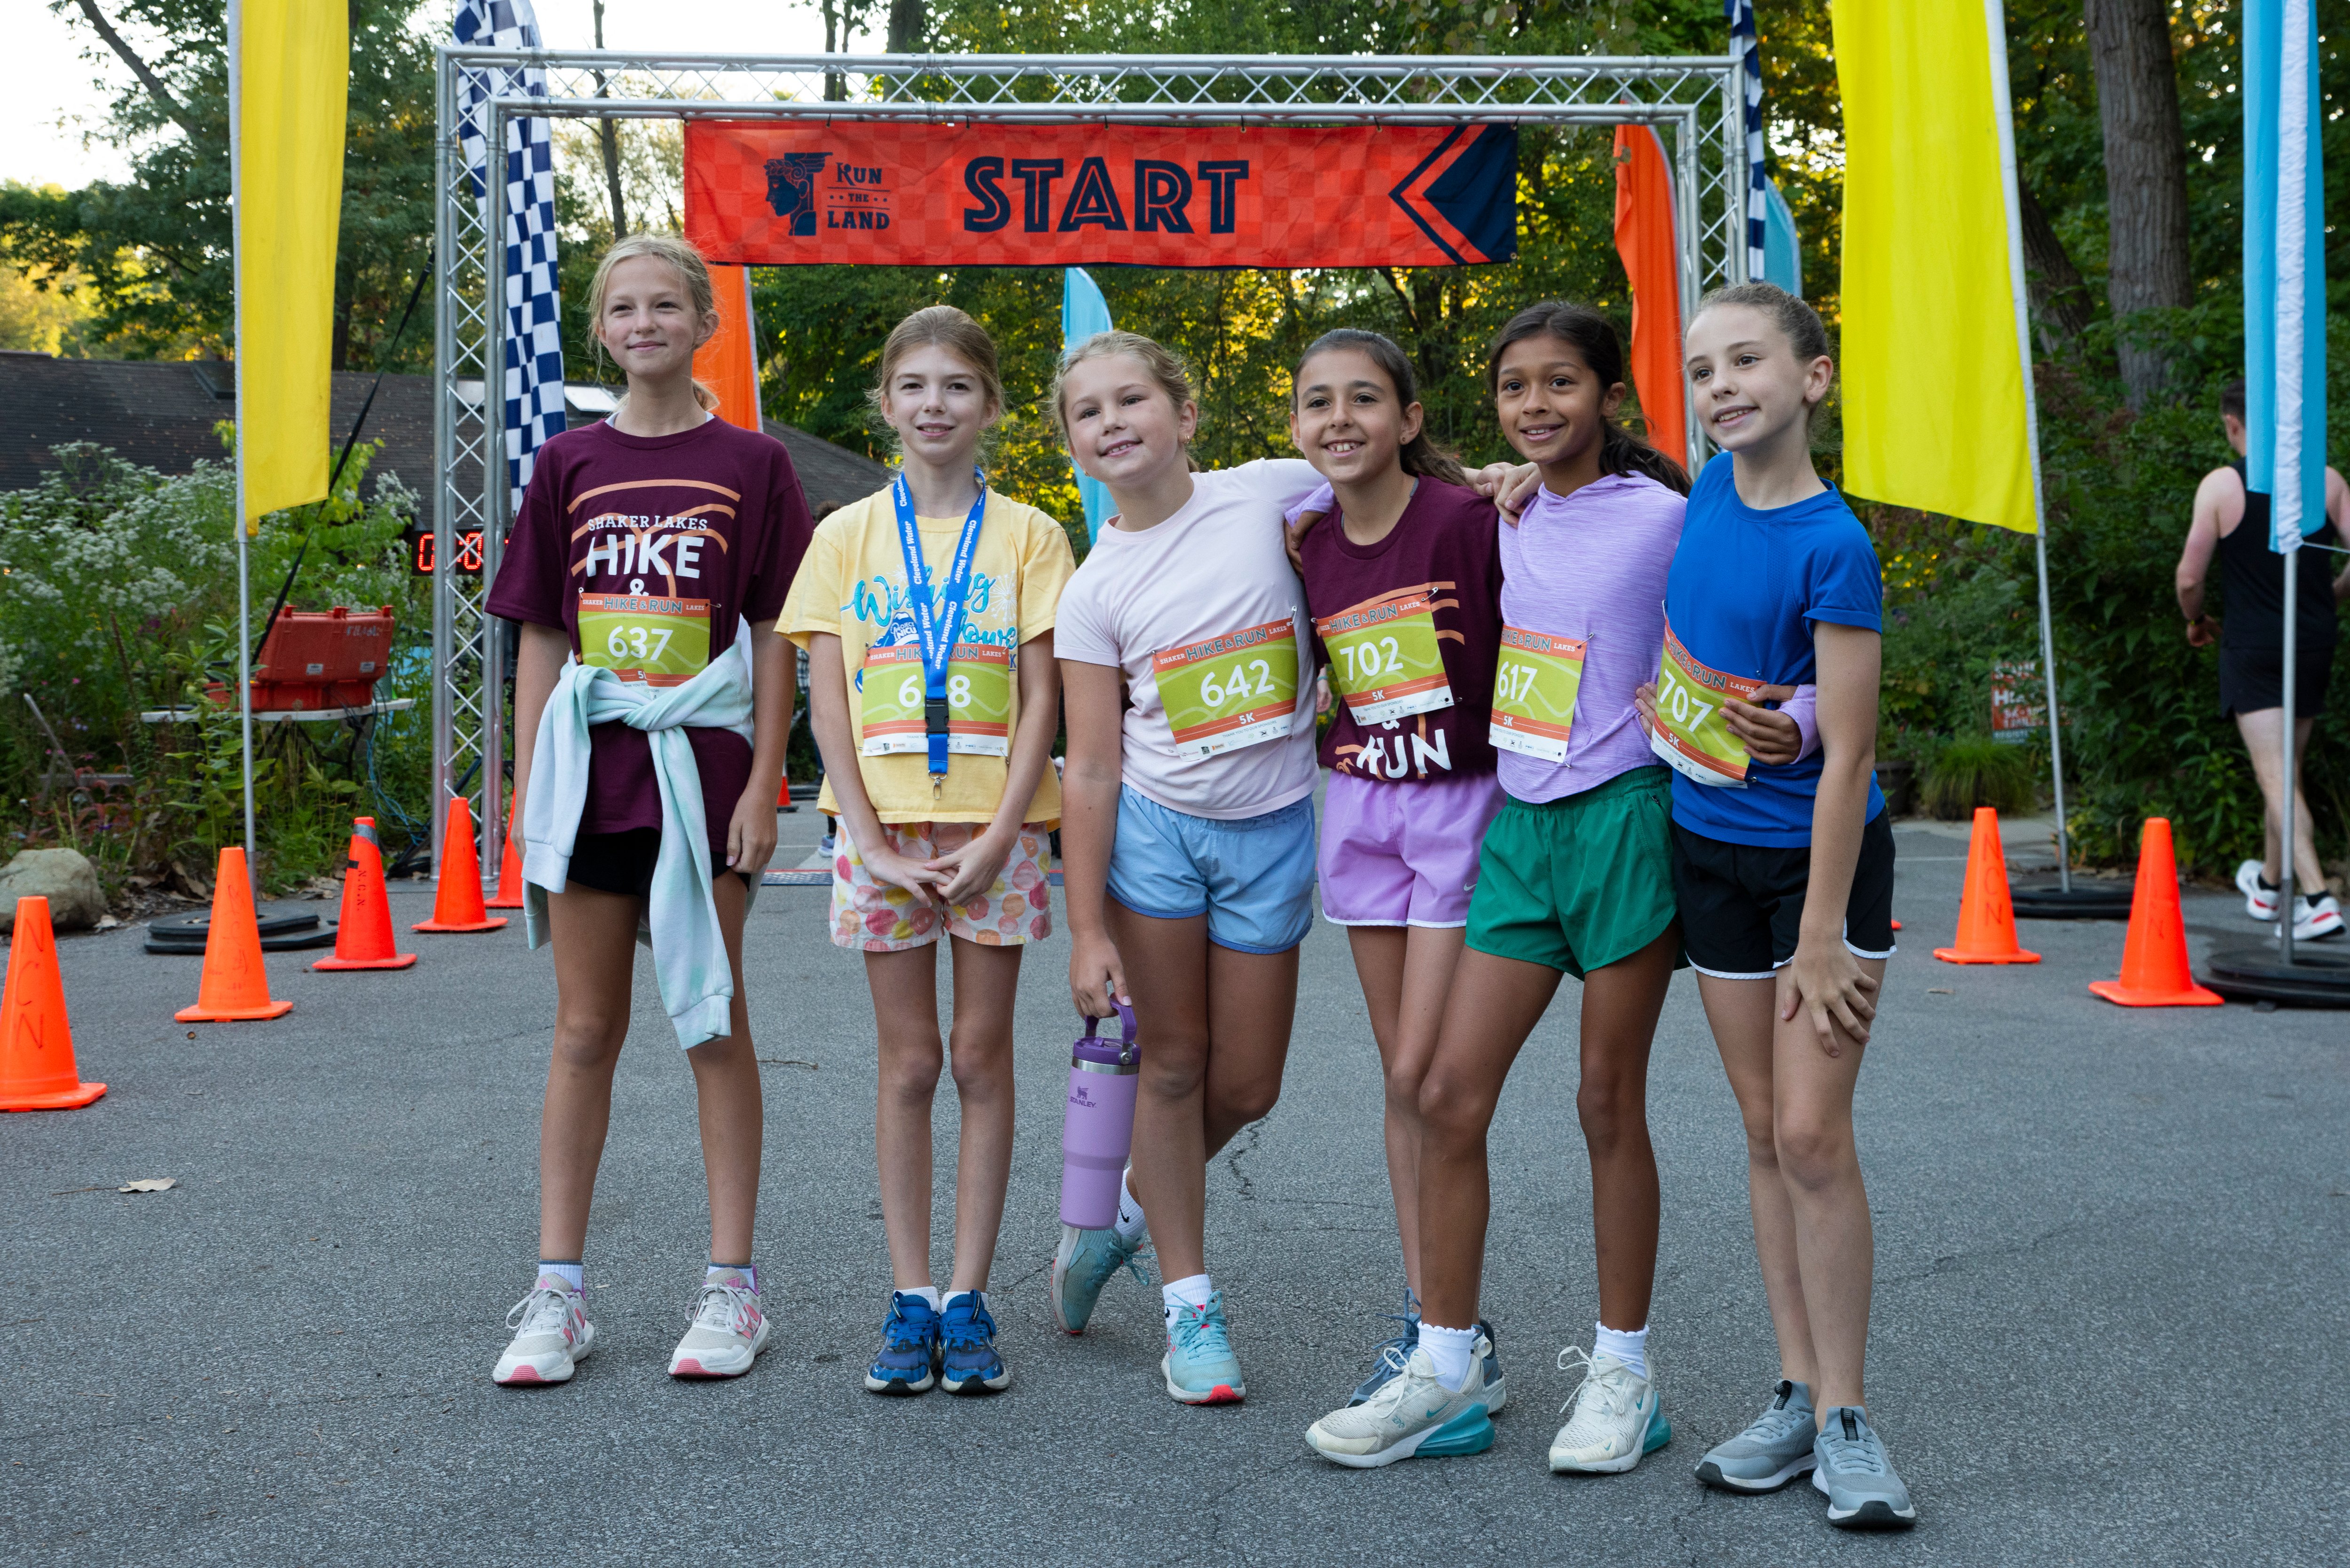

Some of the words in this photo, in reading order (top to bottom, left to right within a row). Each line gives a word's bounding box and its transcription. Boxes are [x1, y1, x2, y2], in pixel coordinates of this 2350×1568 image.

[836, 163, 882, 186] RUN
[848, 193, 870, 203] THE
[964, 156, 1249, 234] START
[827, 211, 890, 230] LAND
[588, 515, 650, 531] SHAKER
[654, 515, 708, 531] LAKES
[904, 521, 915, 545] Water
[960, 520, 977, 558] Cleveland
[586, 533, 705, 579] HIKE
[908, 546, 922, 585] Cleveland
[954, 559, 967, 584] Water
[604, 597, 639, 611] HIKE
[639, 601, 648, 610] &
[648, 598, 683, 614] RUN
[920, 602, 931, 629] Water
[1329, 613, 1362, 633] HIKE
[1362, 614, 1369, 623] &
[1368, 603, 1398, 623] RUN
[1399, 601, 1421, 611] LAKES
[895, 626, 917, 640] NICU
[940, 601, 957, 643] Cleveland
[608, 625, 674, 662] 637
[870, 652, 895, 660] SHAKER
[895, 647, 923, 660] HIK
[1159, 654, 1185, 665] SHAKER
[1185, 639, 1224, 661] HIKE
[1225, 639, 1234, 648] &
[1233, 627, 1268, 647] RUN
[1269, 626, 1287, 634] LAKES
[1518, 634, 1524, 645] &
[1524, 633, 1552, 652] RUN
[1553, 643, 1576, 652] LAKES
[935, 644, 948, 670] Water
[1340, 636, 1404, 681] 702
[1668, 636, 1688, 669] HIKE
[1692, 663, 1727, 690] RUN
[1730, 682, 1755, 693] LAKES
[898, 674, 971, 708] 68
[1200, 659, 1276, 707] 642
[1497, 661, 1538, 702] 617
[1371, 689, 1386, 702] 5K
[1659, 668, 1714, 733] 707
[1238, 712, 1256, 725] 5K
[1503, 715, 1514, 727] 5K
[1668, 732, 1680, 749] 5K
[1070, 1096, 1097, 1108] STANLEY
